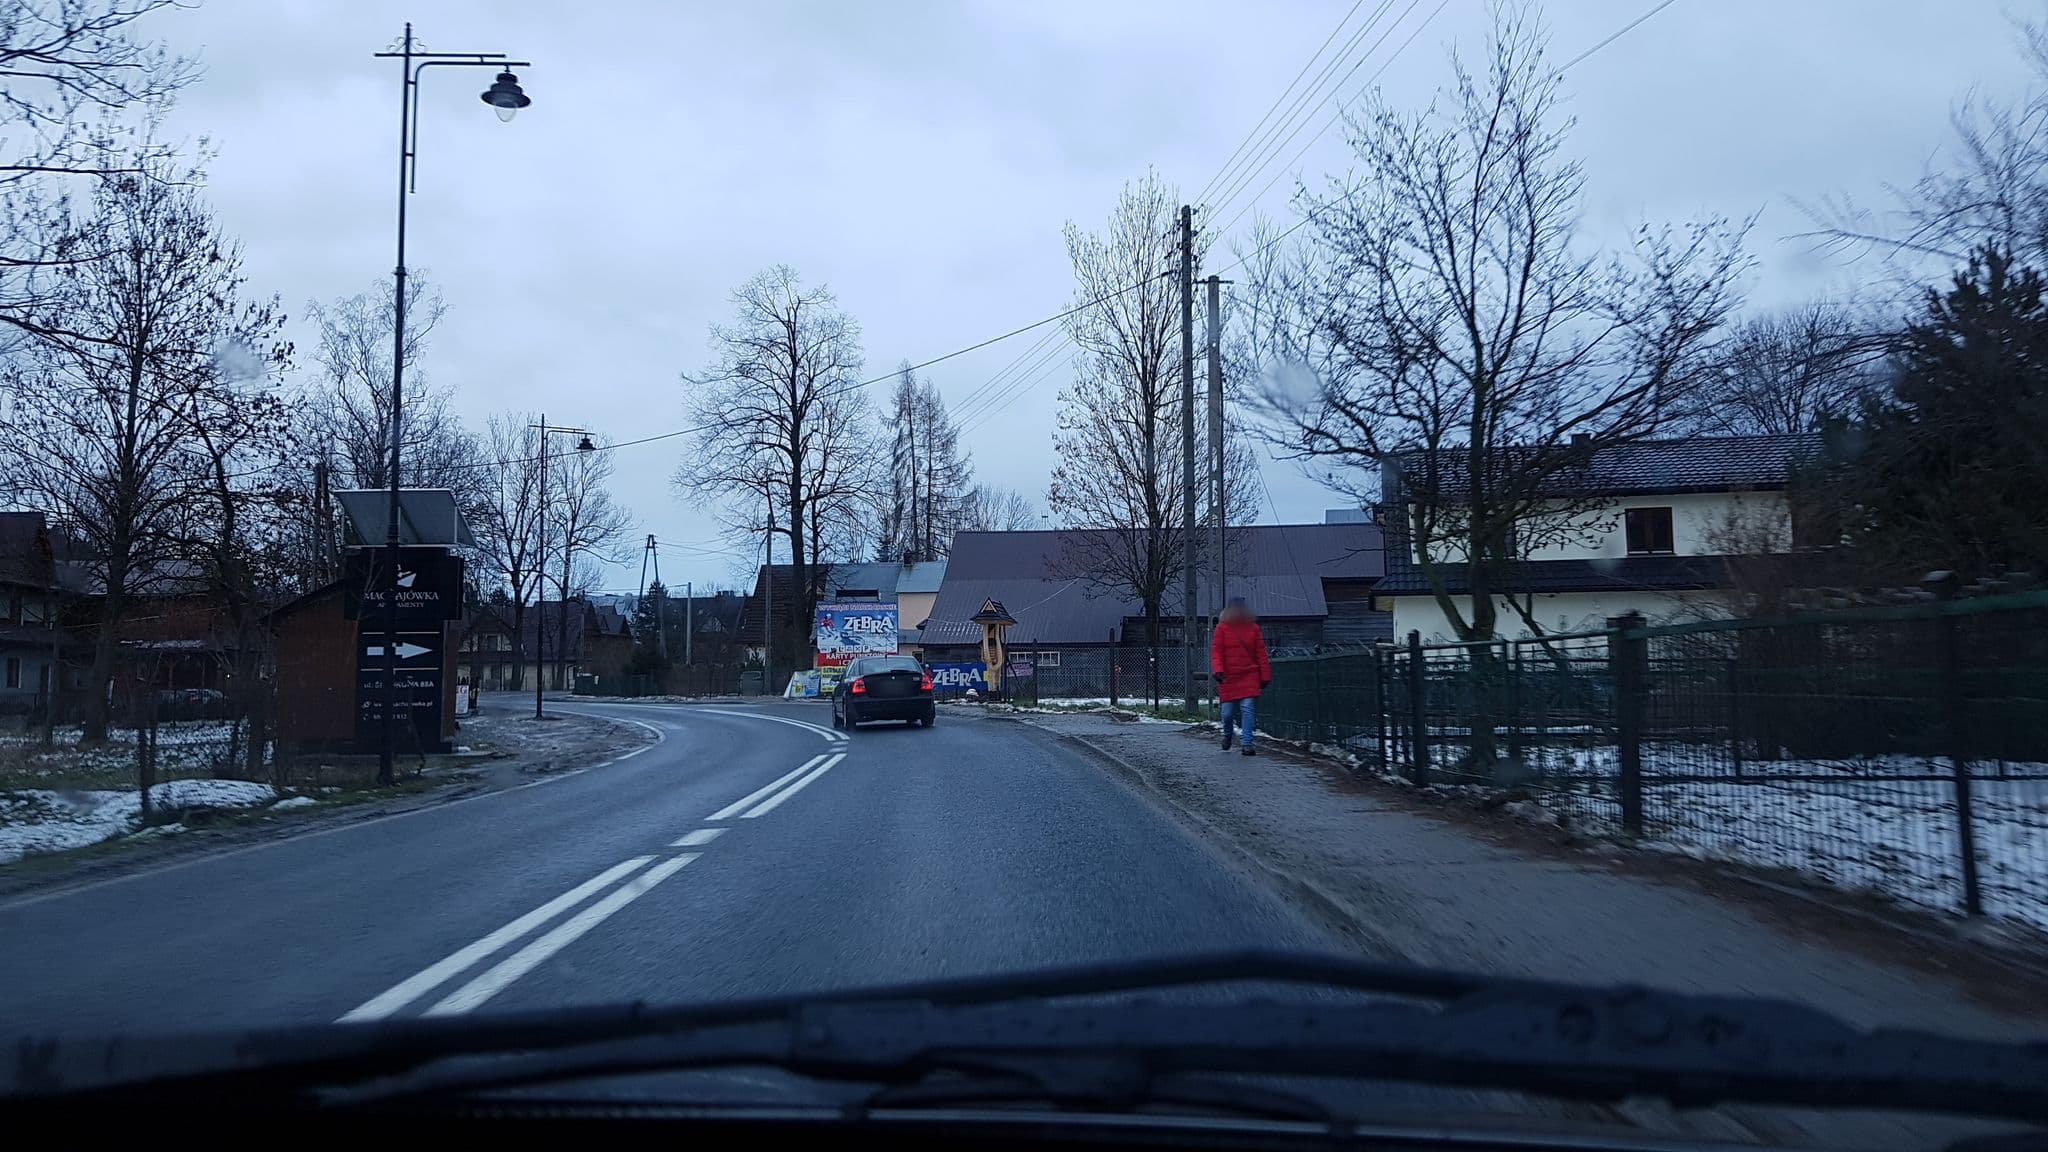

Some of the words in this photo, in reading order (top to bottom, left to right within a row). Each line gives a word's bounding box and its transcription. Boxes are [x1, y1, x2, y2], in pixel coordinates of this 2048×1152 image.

[364, 590, 440, 601] MACAJÓWKA
[843, 616, 893, 633] ZEBRA
[932, 668, 982, 687] ZEBRA
